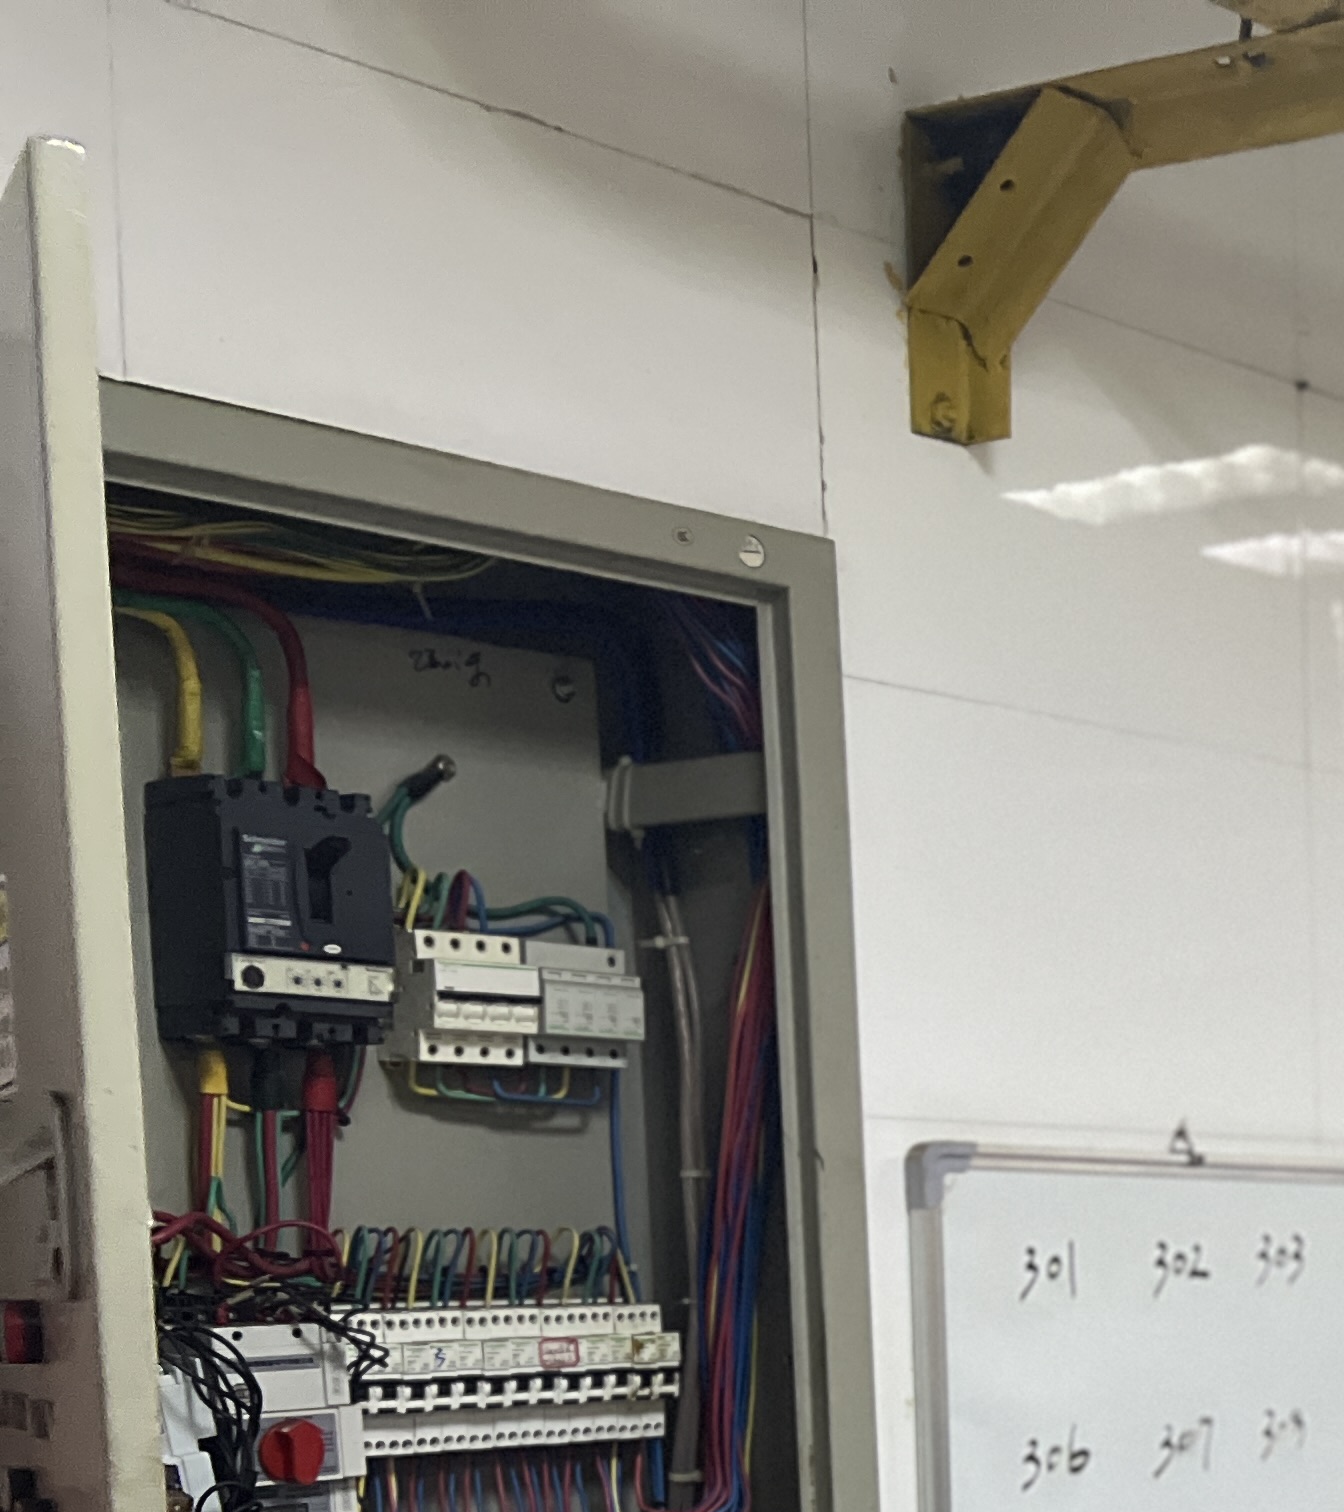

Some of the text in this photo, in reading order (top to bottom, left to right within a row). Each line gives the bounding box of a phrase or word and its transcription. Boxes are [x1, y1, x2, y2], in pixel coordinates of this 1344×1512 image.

[1018, 1238, 1076, 1301] 301
[1152, 1240, 1211, 1299] 302
[1256, 1233, 1304, 1287] 303
[1021, 1422, 1091, 1491] 306
[1152, 1416, 1213, 1479] 307
